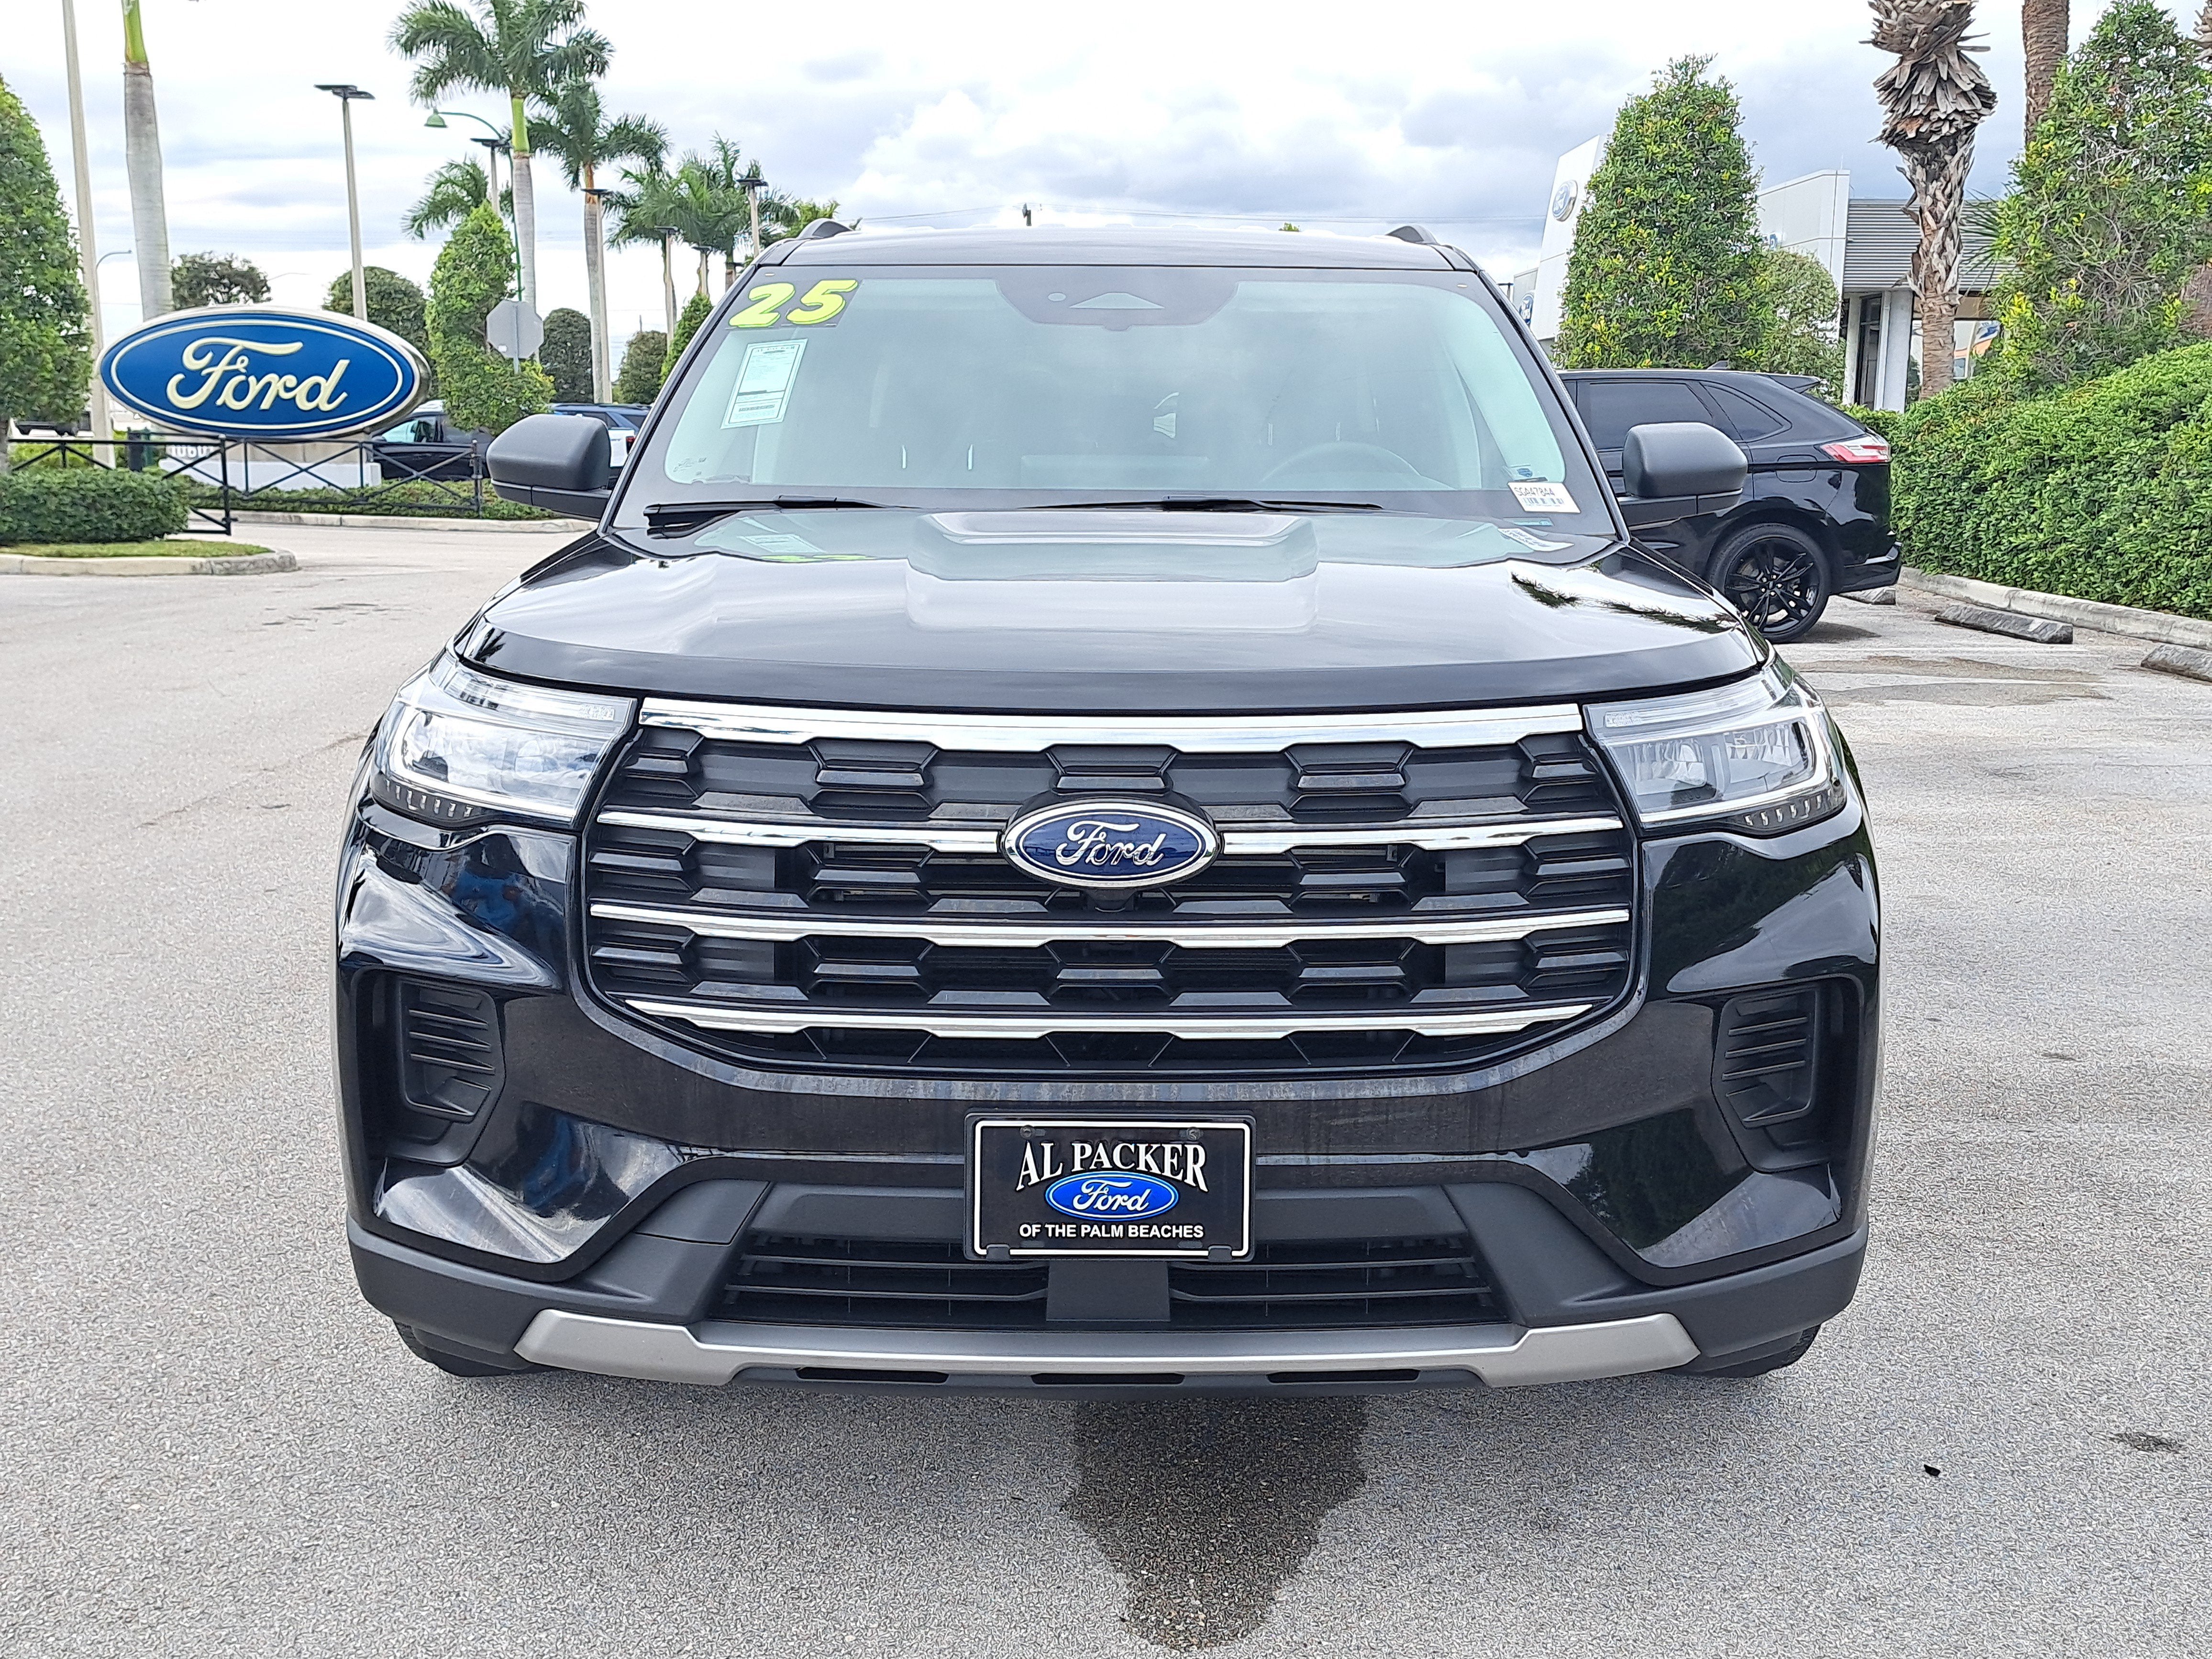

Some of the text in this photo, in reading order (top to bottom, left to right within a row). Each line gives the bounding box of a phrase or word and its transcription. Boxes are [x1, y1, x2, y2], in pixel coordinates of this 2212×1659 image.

[729, 279, 858, 328] 25
[166, 337, 350, 412] Ford
[1055, 820, 1167, 866] Ford
[1016, 1140, 1208, 1192] AL PACKER
[1073, 1179, 1152, 1211] Ford
[1019, 1224, 1204, 1238] OF THE PALM BEACHES
